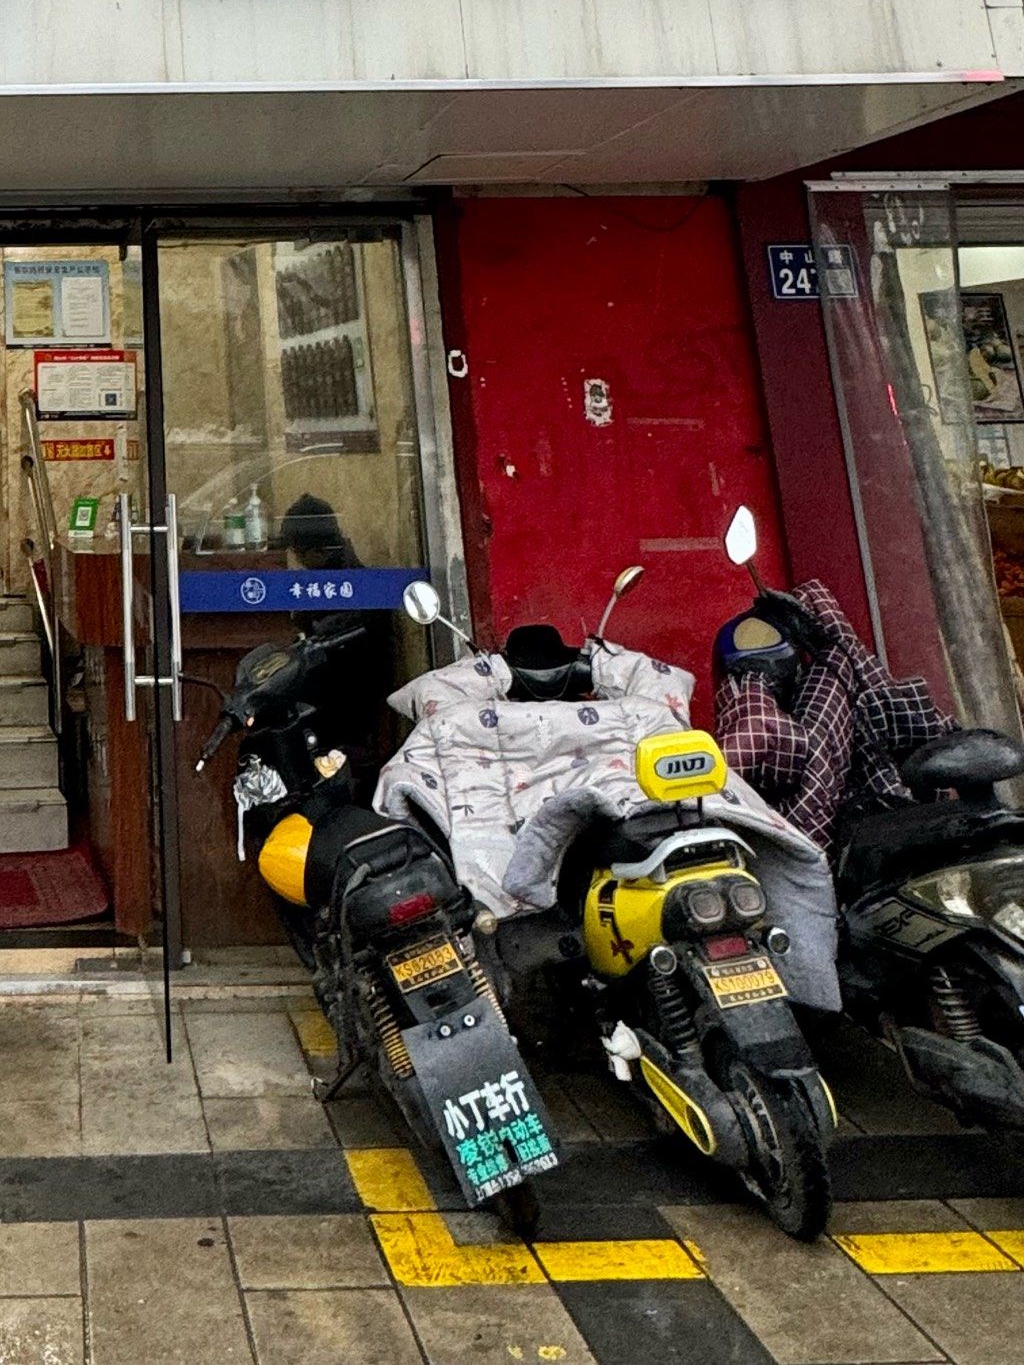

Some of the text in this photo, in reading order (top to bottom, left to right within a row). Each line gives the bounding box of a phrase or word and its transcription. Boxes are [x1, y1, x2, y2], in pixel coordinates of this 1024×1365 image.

[779, 267, 818, 295] 24
[442, 1070, 530, 1140] 小丁车行
